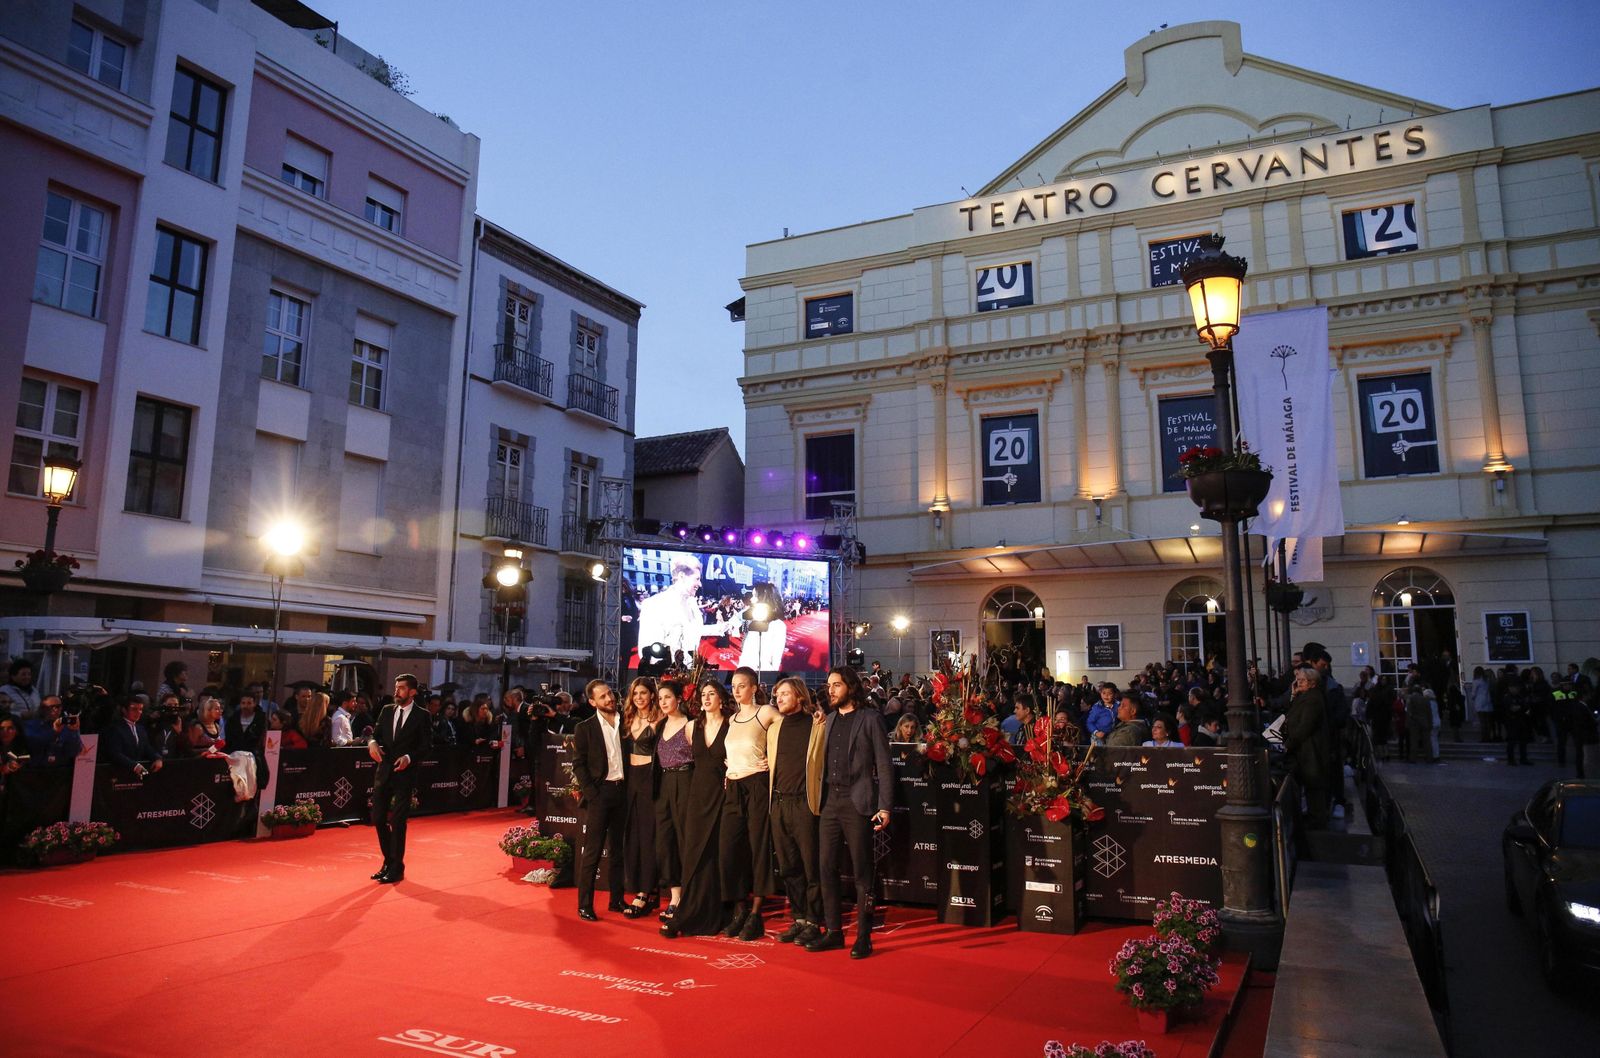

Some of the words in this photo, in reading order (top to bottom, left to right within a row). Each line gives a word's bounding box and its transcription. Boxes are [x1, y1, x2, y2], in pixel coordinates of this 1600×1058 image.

[959, 182, 1118, 231] TEATRO
[1151, 125, 1427, 198] CERVANTES
[1167, 412, 1212, 426] FESTIVAL
[1282, 397, 1296, 443] MÁLAGA
[1379, 398, 1419, 428] 20
[1167, 427, 1178, 435] DE
[993, 436, 1025, 461] 20
[1287, 446, 1296, 462] DE
[1288, 463, 1300, 513] FESTIVAL
[296, 791, 331, 799] ATRESMEDIA
[136, 808, 186, 820] ATRESMEDIA
[545, 815, 578, 824] ATRESMED
[946, 862, 978, 872] Cruzcampo
[1153, 855, 1218, 866] ATRESMEDIA
[951, 896, 975, 904] SUR
[632, 946, 708, 960] ATRESMEDIA
[560, 969, 664, 989] gasNatural
[604, 983, 674, 997] fenosa
[485, 995, 623, 1024] Cruzcampo
[395, 1028, 517, 1058] SUR
